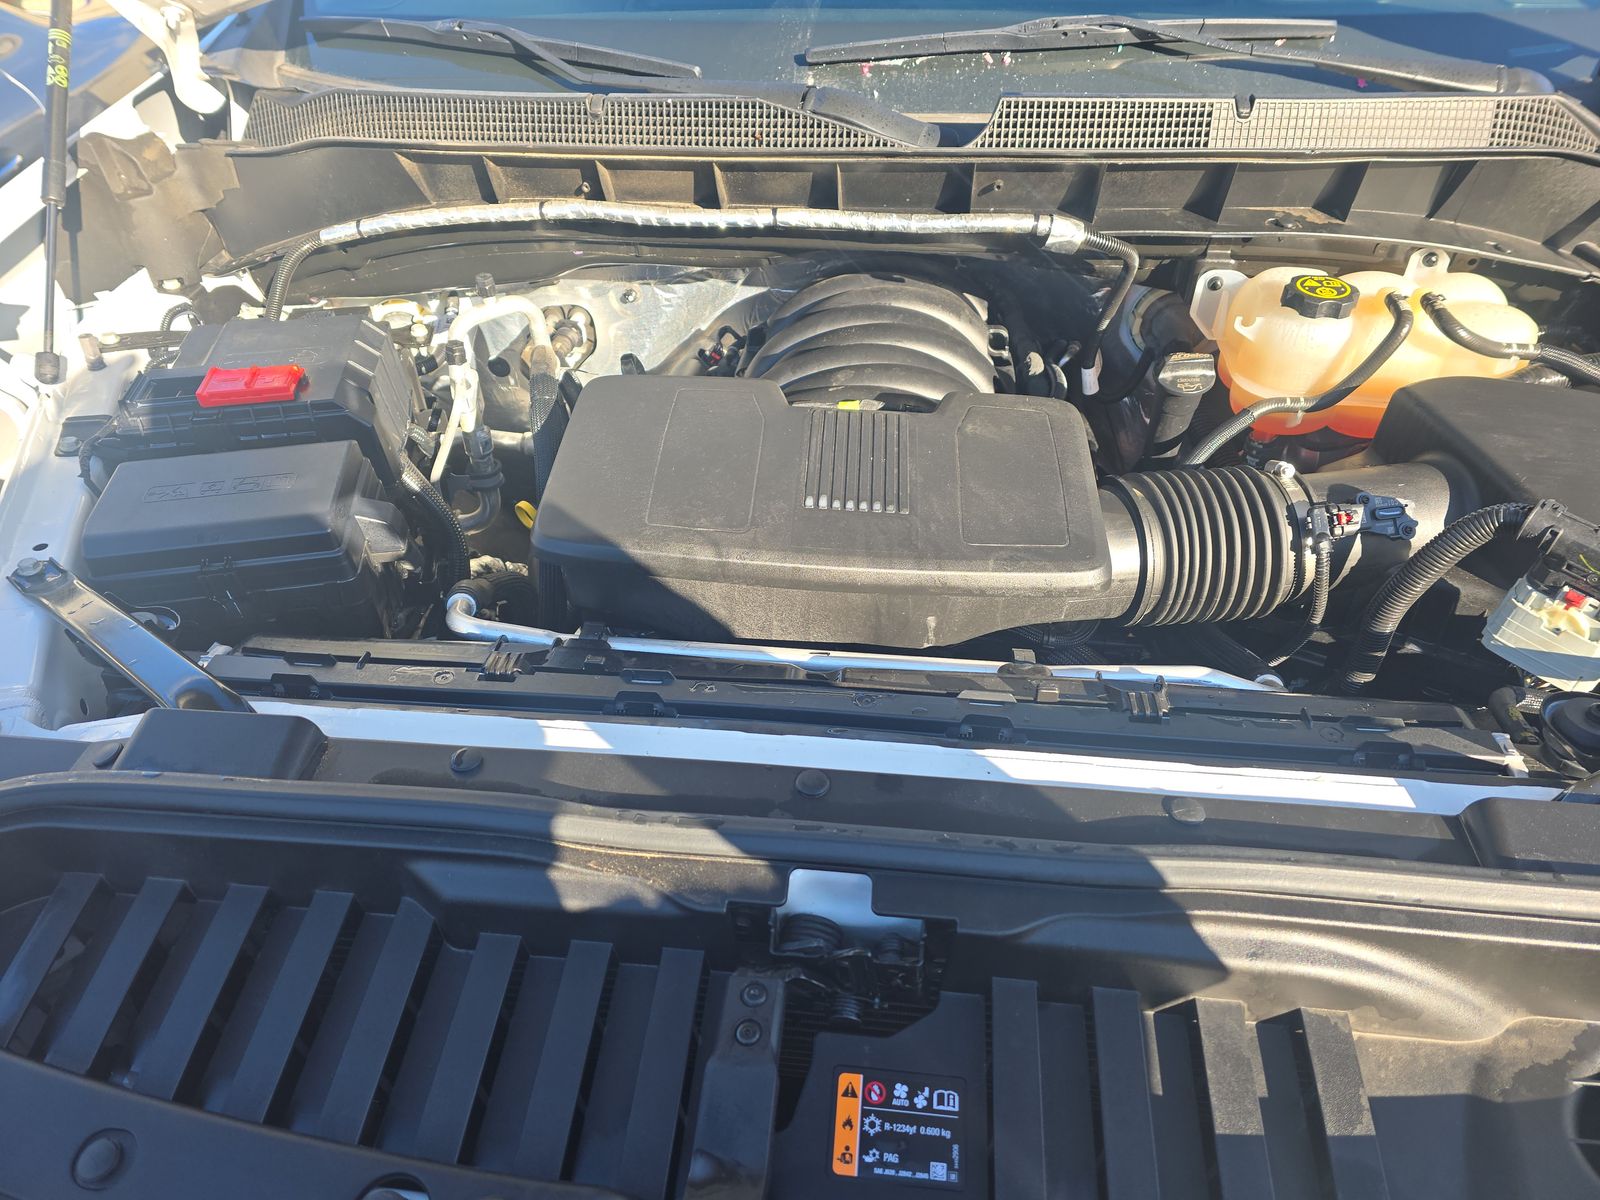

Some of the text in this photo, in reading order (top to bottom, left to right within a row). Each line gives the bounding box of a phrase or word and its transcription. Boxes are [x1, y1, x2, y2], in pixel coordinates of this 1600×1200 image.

[892, 1098, 909, 1107] AUTO
[884, 1122, 917, 1136] R-1234yf
[941, 1128, 951, 1139] kg
[883, 1152, 899, 1163] PAG
